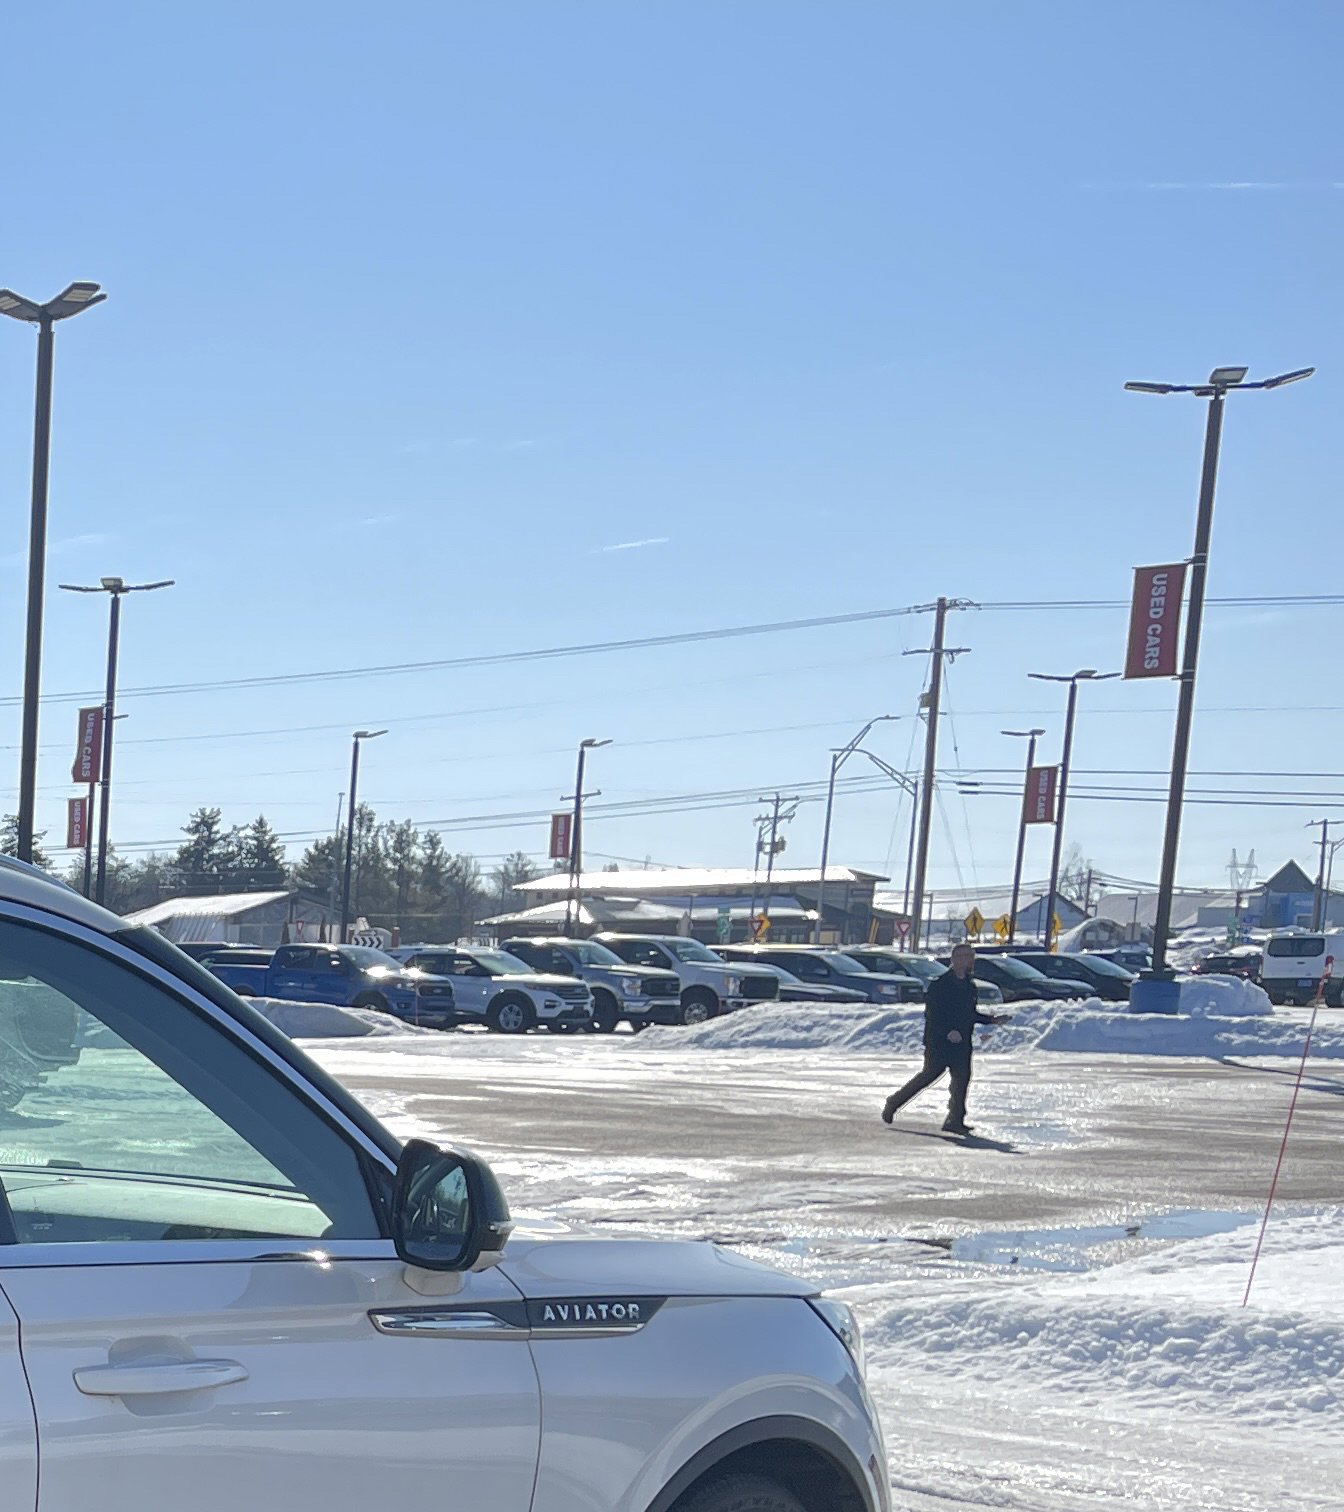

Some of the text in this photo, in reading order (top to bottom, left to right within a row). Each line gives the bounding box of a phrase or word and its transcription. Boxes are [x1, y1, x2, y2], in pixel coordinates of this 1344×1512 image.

[1144, 573, 1168, 670] USED CARS
[81, 713, 95, 778] USED CARS
[542, 1303, 640, 1322] AVIATOR
